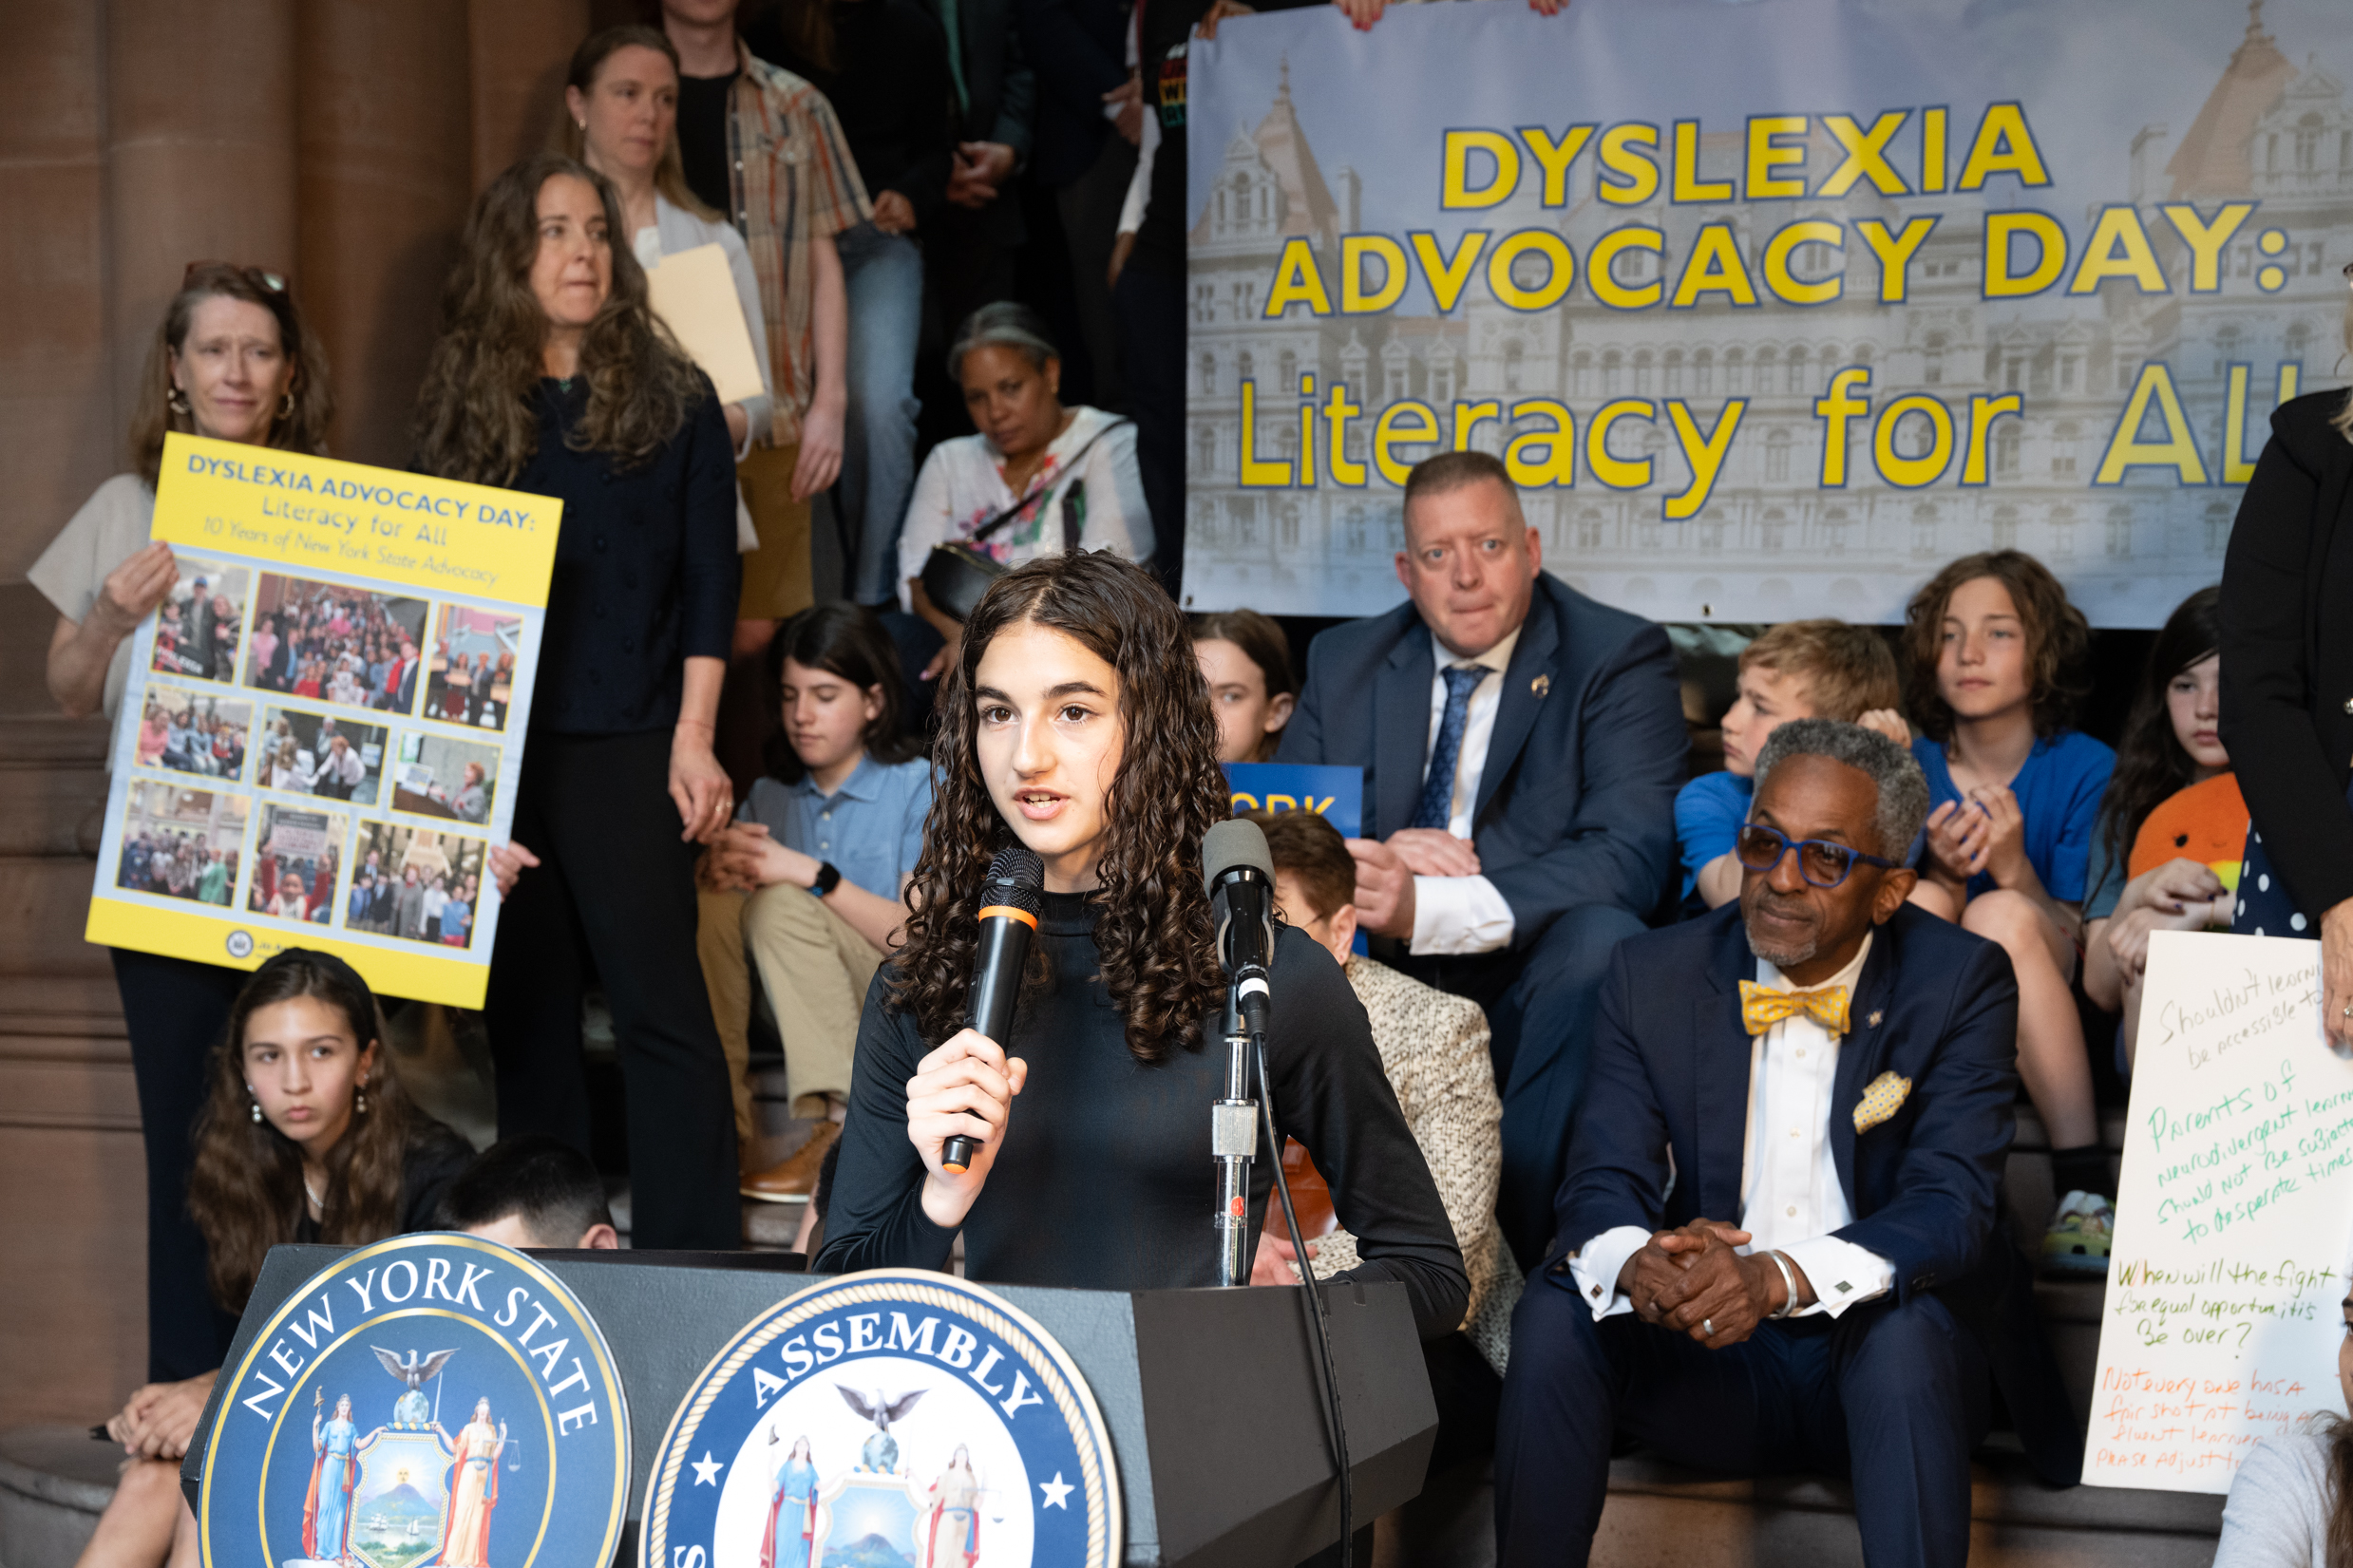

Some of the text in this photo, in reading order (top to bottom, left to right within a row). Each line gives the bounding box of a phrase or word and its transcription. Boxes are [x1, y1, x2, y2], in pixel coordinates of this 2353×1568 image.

[1440, 101, 2054, 211] DYSLEXIA
[1262, 199, 2290, 319] ADVOCACY DAY:
[1238, 371, 1750, 521] Literacy
[1813, 366, 2024, 490] for
[187, 453, 536, 532] DYSLEXIA ADVOCACY DAY:
[261, 495, 447, 546] Literacy for All
[202, 515, 500, 591] 10 Years of New York State Advocacy
[2148, 1086, 2254, 1153] Parents
[2182, 1219, 2210, 1245] to
[2183, 1257, 2225, 1286] will
[2228, 1261, 2268, 1287] the
[2273, 1259, 2338, 1298] fight
[242, 1257, 599, 1437] NEW YORK STATE
[751, 1311, 1045, 1421] ASSEMBLY
[2102, 1366, 2151, 1392] Not
